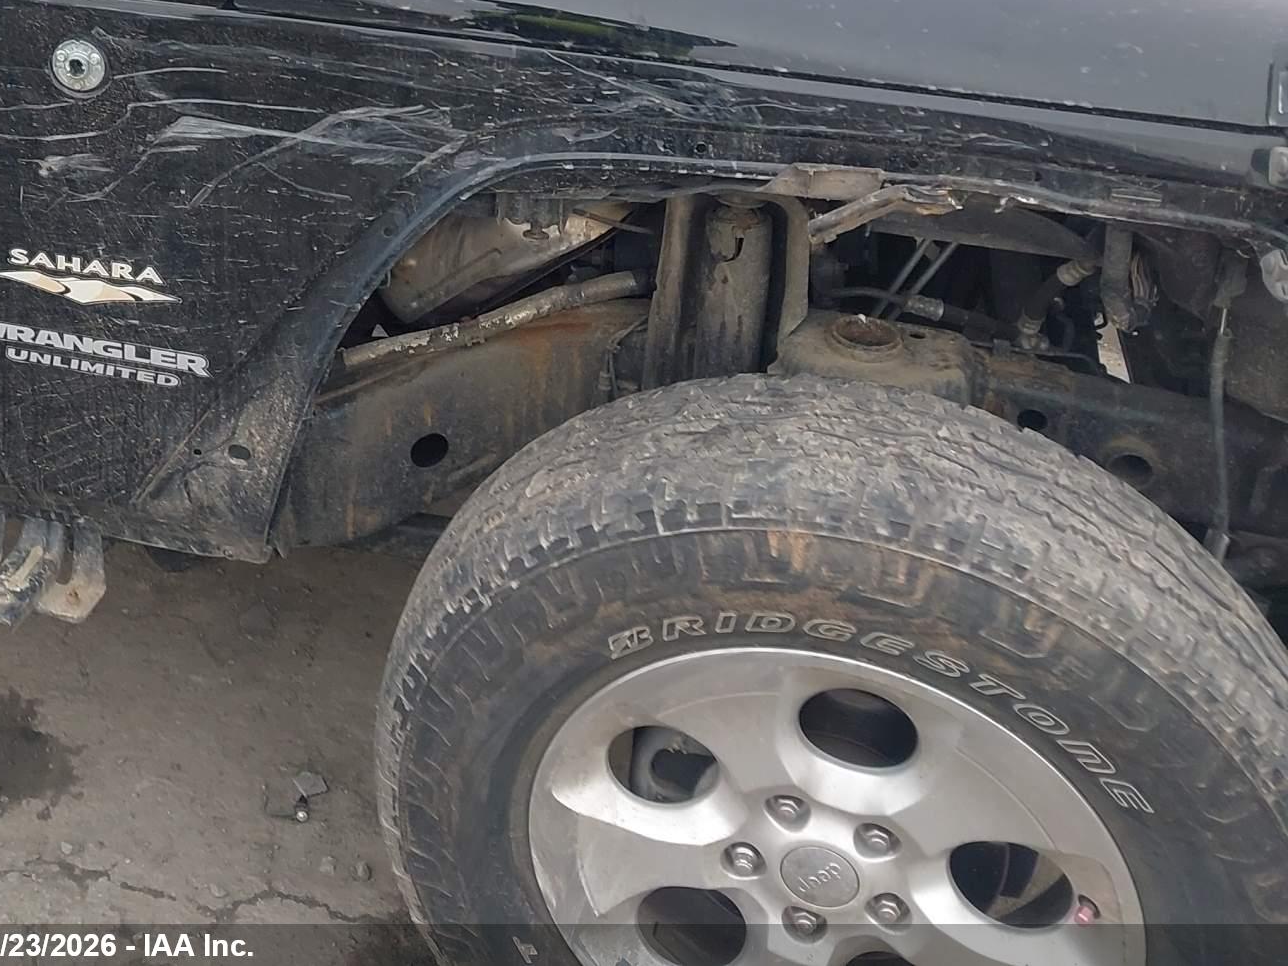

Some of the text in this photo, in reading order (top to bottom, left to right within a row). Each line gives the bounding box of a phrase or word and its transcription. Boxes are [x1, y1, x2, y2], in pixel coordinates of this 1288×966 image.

[8, 248, 165, 285] SAHARA
[5, 347, 181, 386] UNLIMITED
[608, 610, 1154, 815] BRIDGESTONE
[798, 861, 842, 893] Jeep
